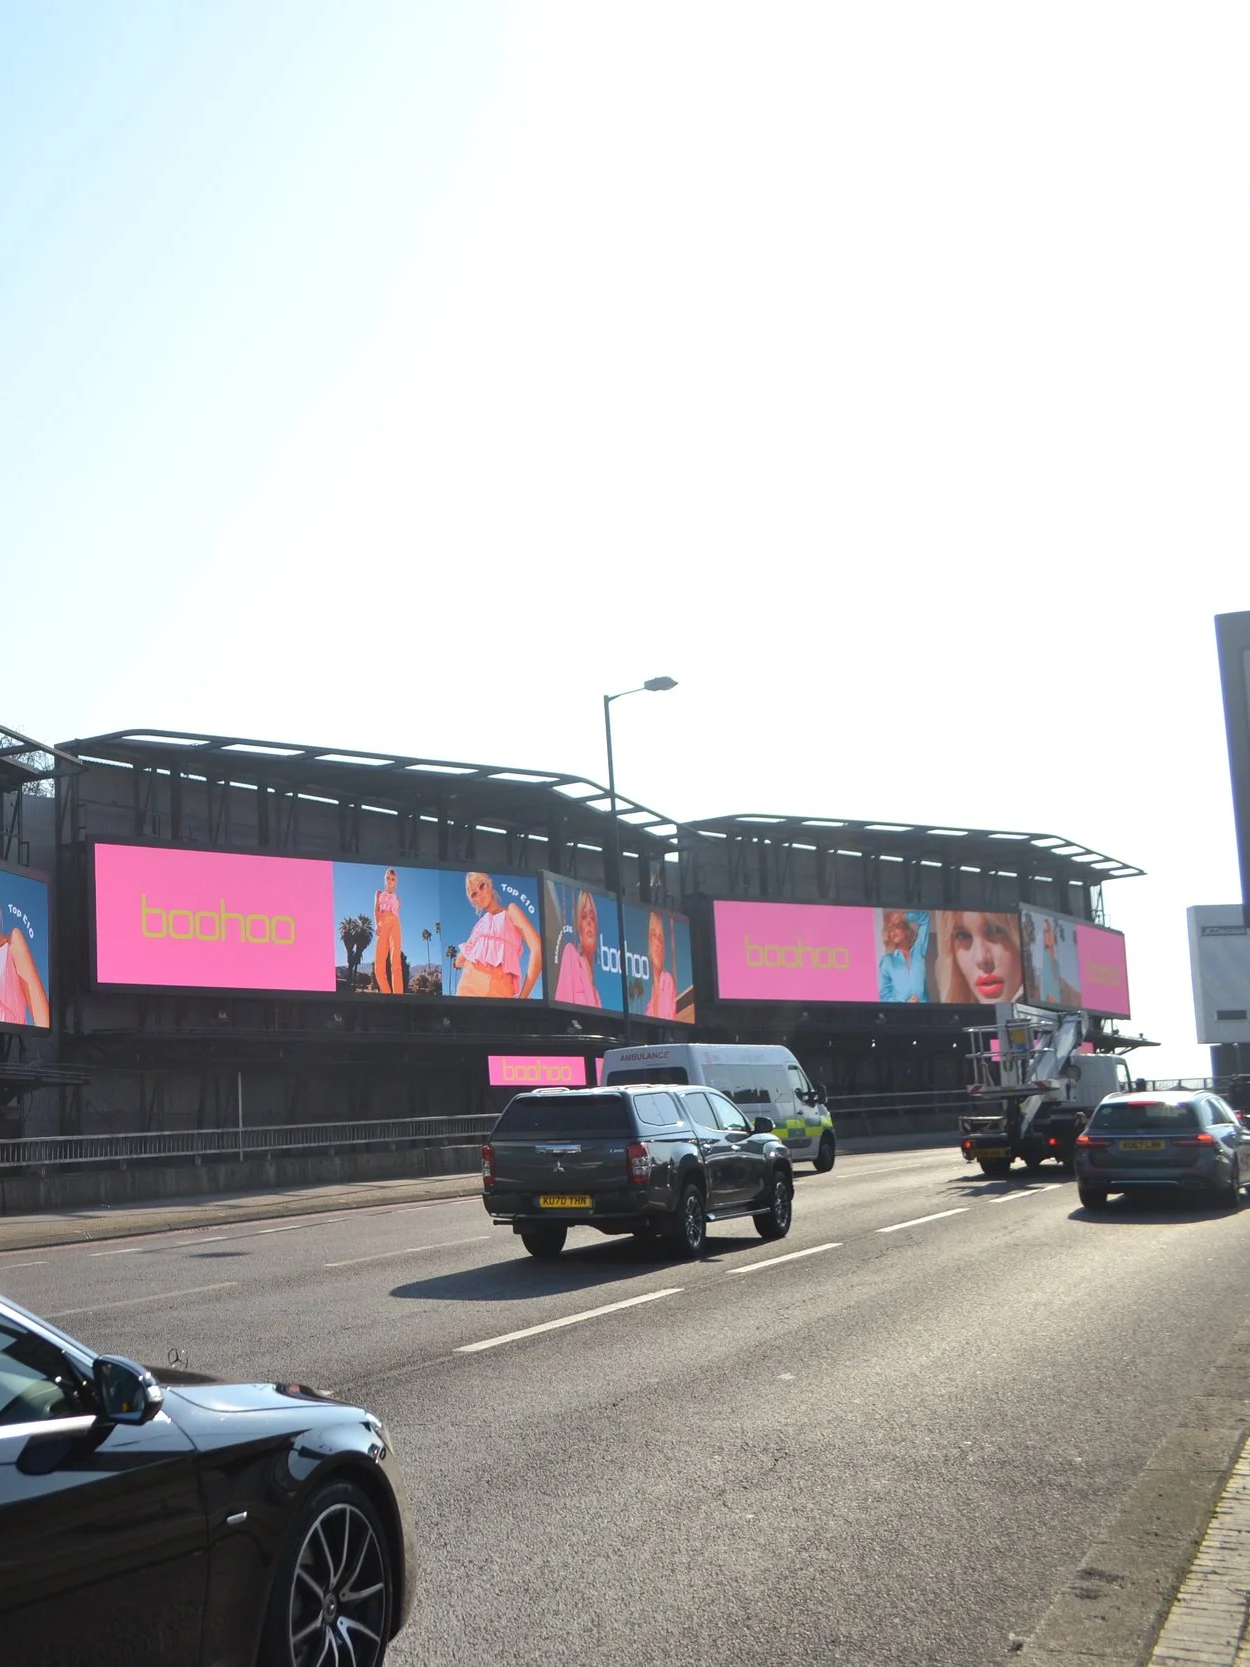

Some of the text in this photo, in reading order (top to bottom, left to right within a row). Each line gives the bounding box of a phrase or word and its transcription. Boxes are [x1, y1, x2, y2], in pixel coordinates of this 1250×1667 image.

[501, 883, 535, 914] Top £10
[8, 904, 35, 939] Top £10
[141, 894, 296, 945] boohoo
[745, 936, 849, 970] boohoo
[502, 1056, 572, 1081] boohoo
[620, 1051, 669, 1062] AMBULANCE
[542, 1195, 587, 1205] KU70 YHN
